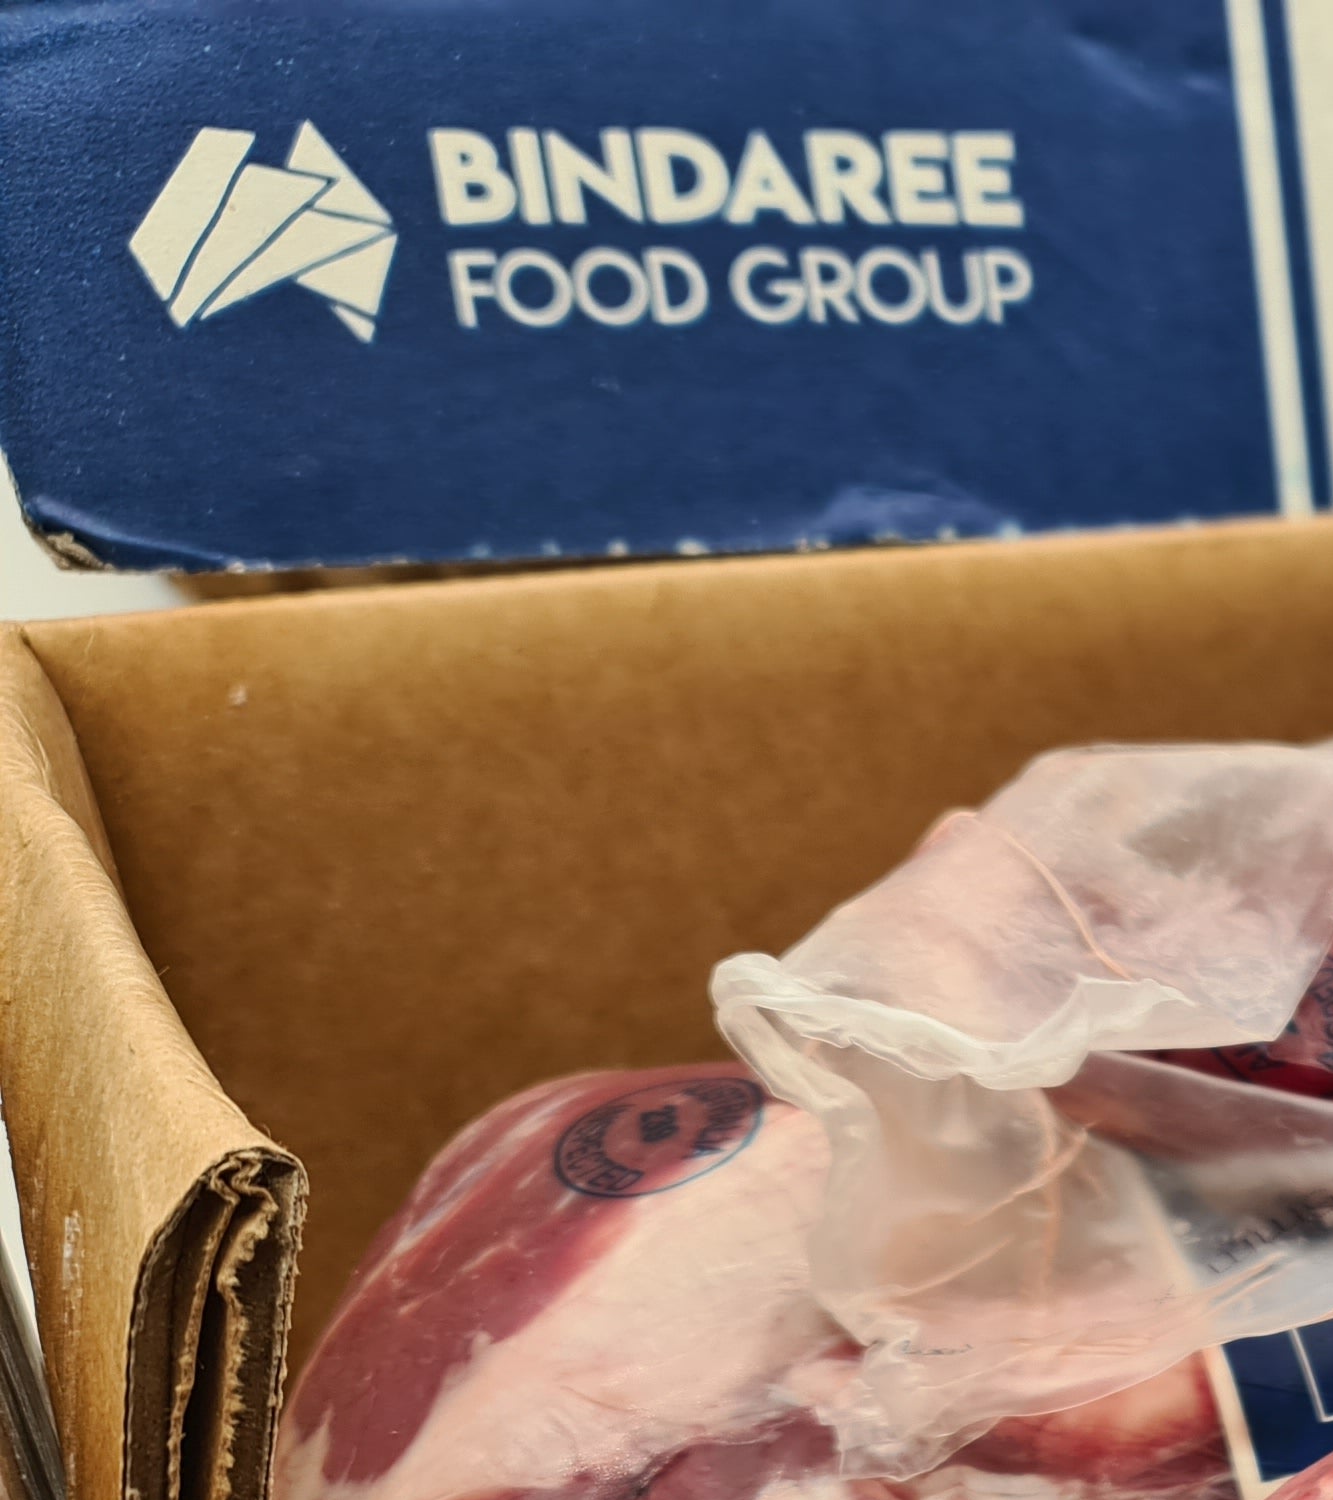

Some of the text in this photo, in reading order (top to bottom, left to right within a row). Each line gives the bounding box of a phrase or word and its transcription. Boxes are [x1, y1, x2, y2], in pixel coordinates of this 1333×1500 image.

[428, 126, 1027, 229] BINDAREE
[447, 246, 1034, 328] FOOD GROUP
